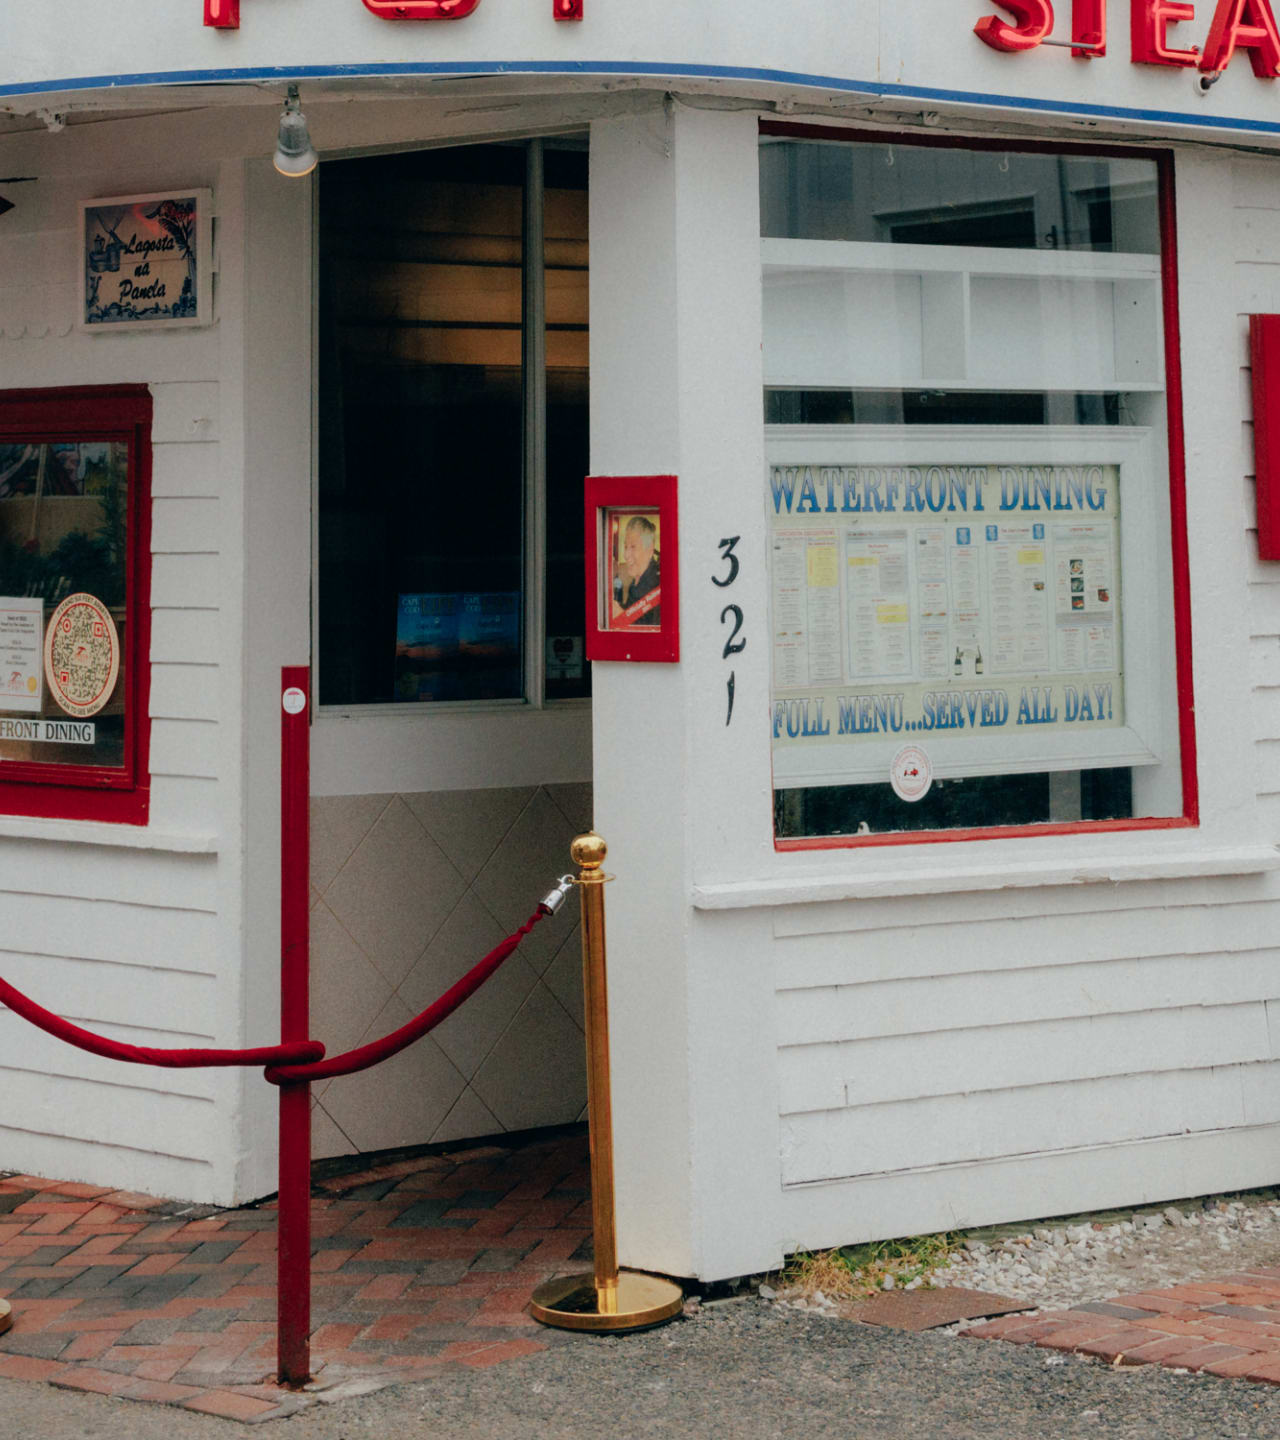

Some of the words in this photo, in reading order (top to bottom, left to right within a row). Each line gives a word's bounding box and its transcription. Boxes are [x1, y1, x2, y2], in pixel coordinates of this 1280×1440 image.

[770, 464, 990, 514] WATERFRONT
[997, 464, 1108, 512] DINING
[45, 722, 92, 743] DINING
[772, 697, 831, 739] FULL
[1016, 686, 1058, 726] ALL
[1063, 683, 1114, 723] DAY!
